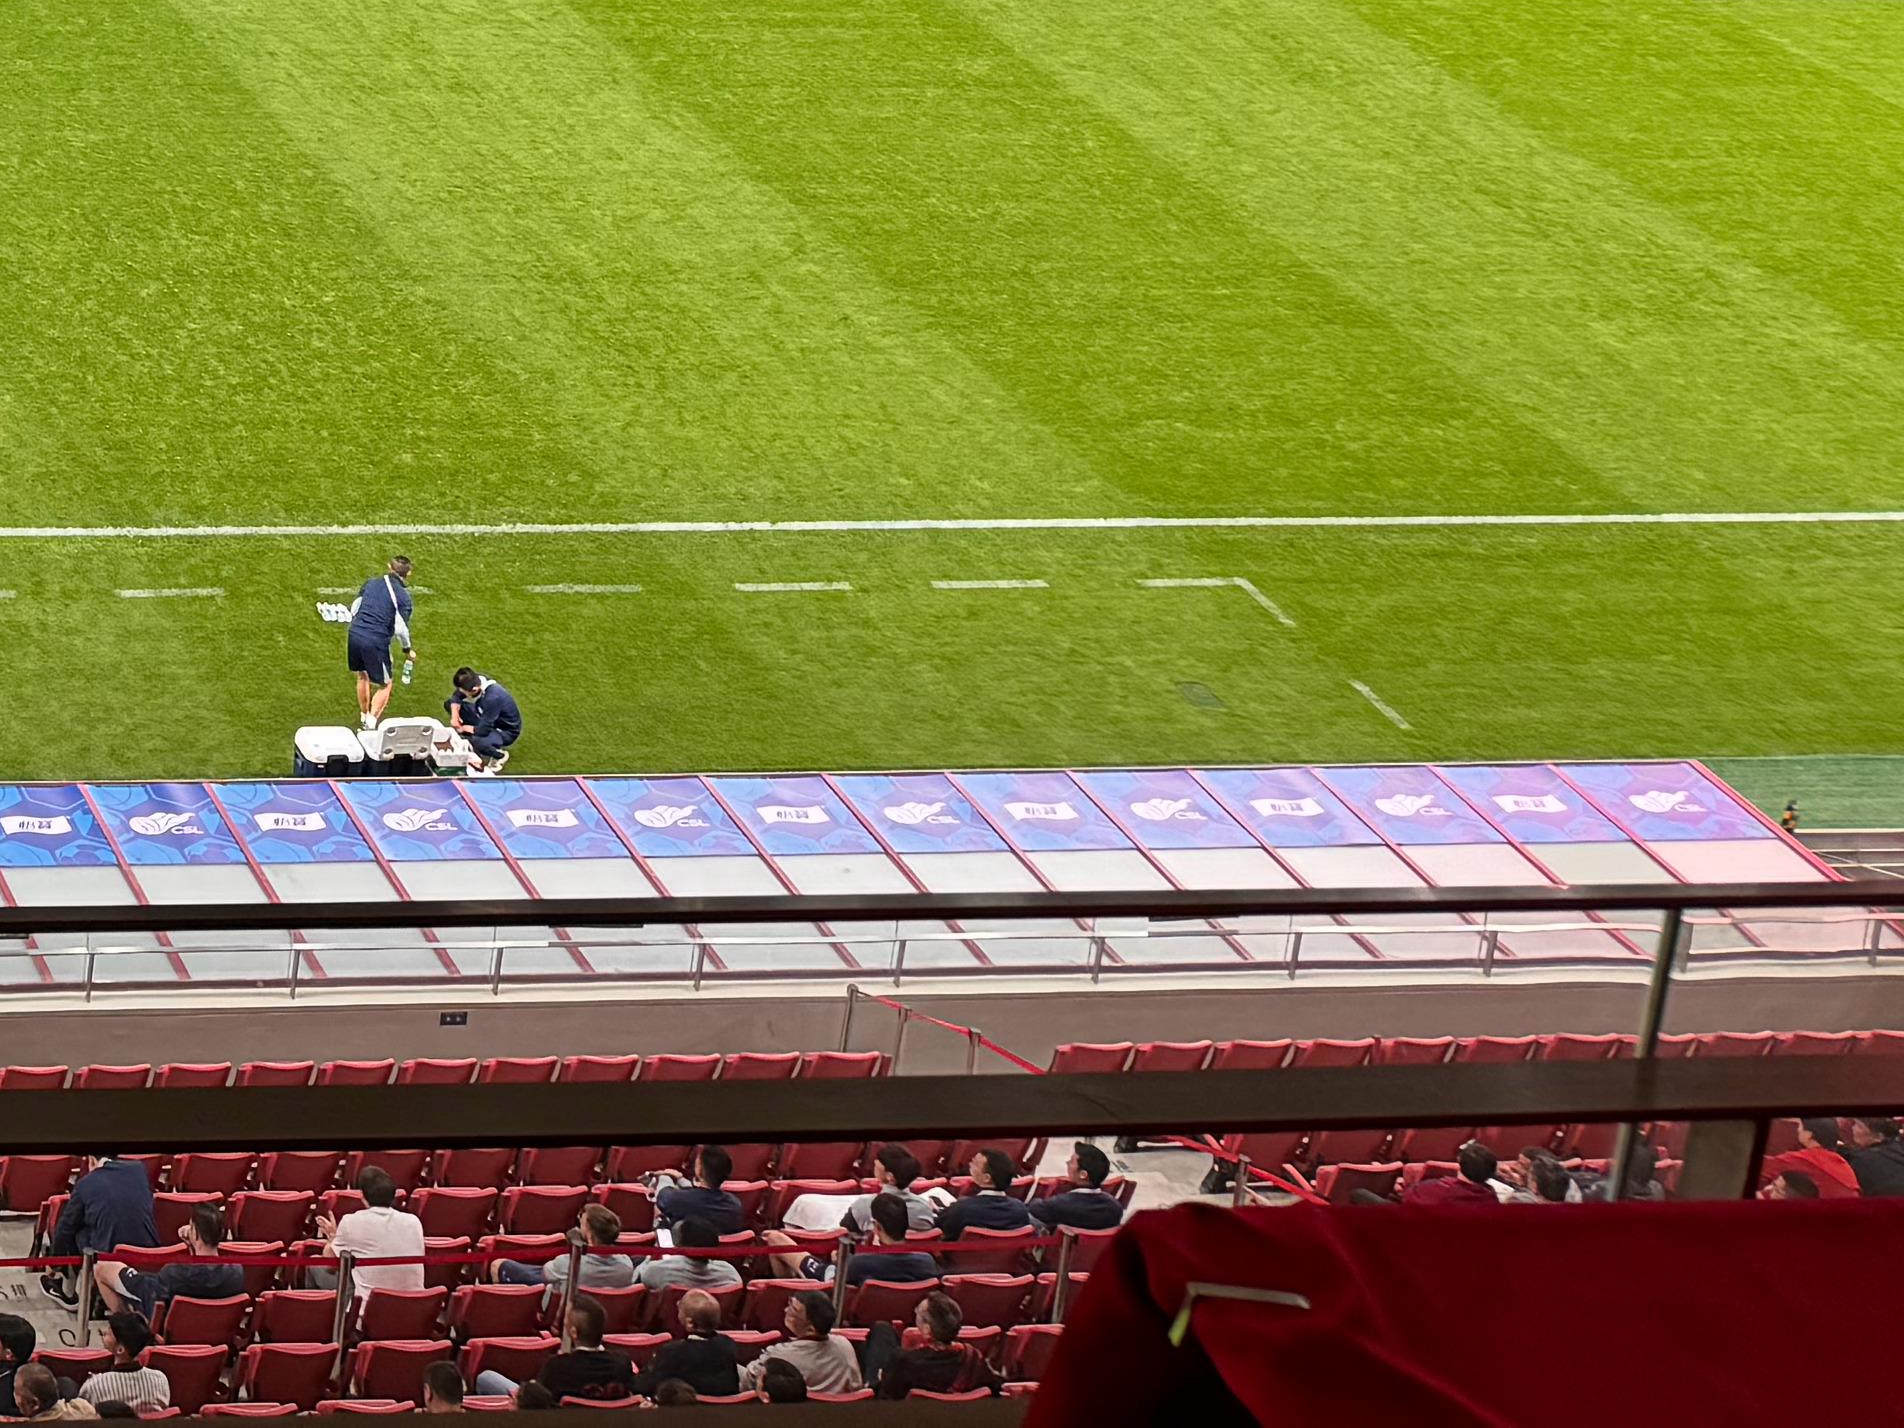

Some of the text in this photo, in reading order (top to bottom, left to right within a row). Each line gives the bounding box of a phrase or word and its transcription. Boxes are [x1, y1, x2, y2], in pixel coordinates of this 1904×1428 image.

[425, 822, 458, 831] CSL
[677, 819, 710, 827] CSL
[171, 826, 204, 834] CSL
